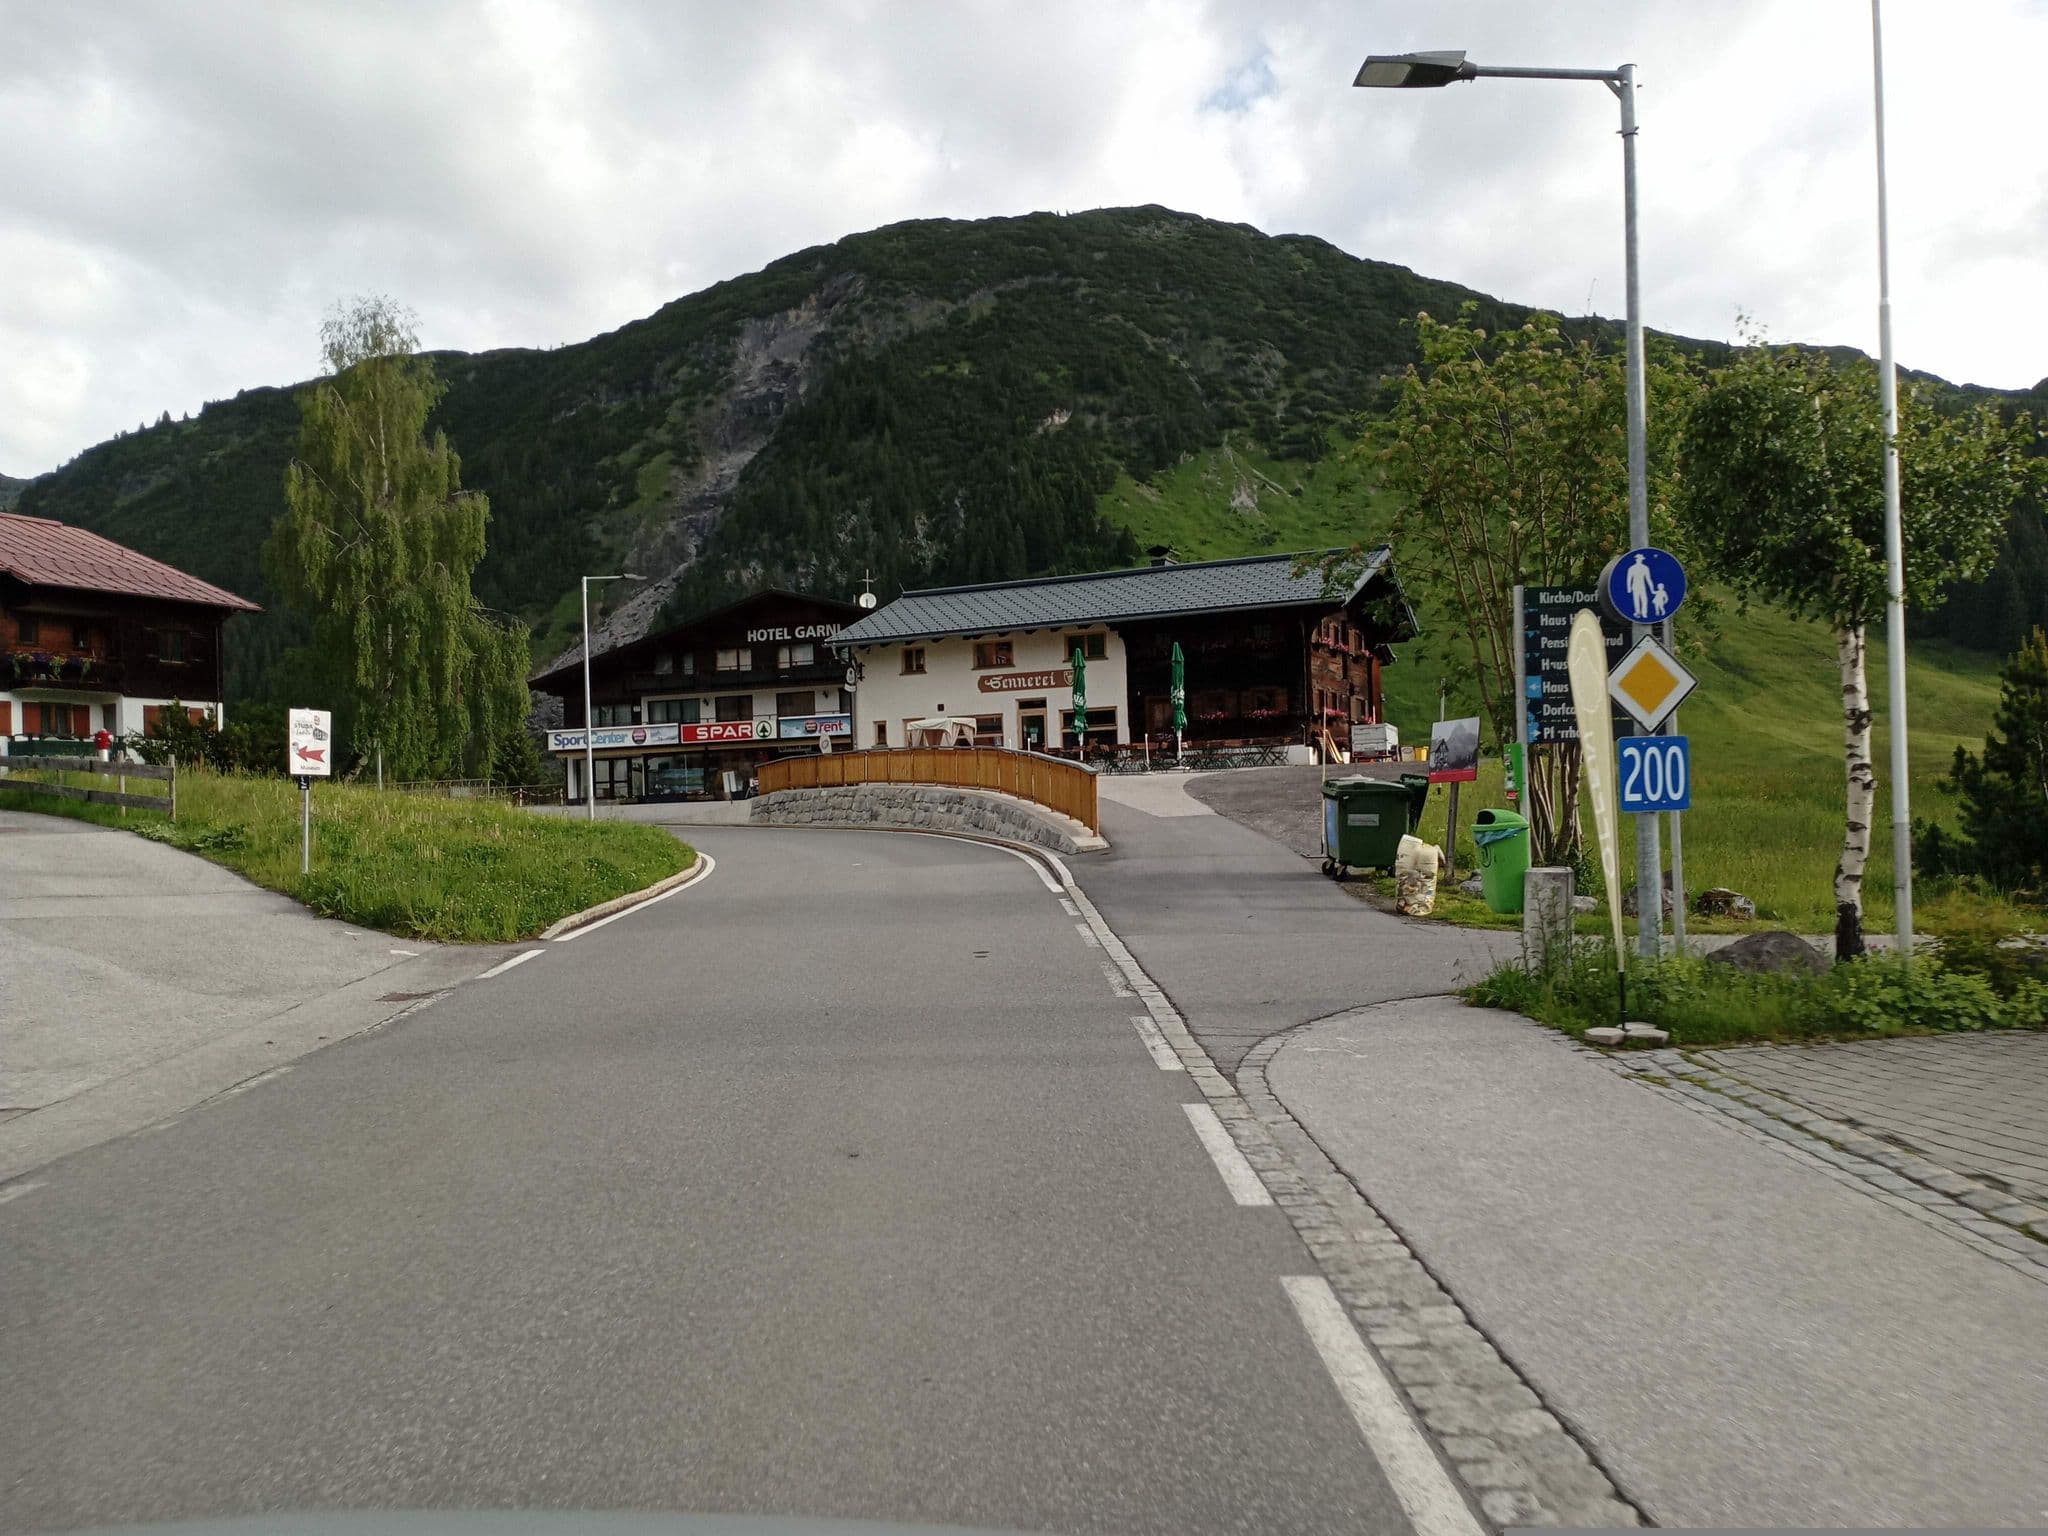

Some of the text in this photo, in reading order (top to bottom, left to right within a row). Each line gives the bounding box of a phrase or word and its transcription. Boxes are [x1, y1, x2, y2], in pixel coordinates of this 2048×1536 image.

[1539, 590, 1600, 604] Kirche/Dorf
[1540, 613, 1567, 626] Haus
[747, 627, 792, 642] HOTEL
[984, 671, 1057, 690] Sennerei
[1542, 681, 1569, 693] Haus
[696, 726, 753, 740] SPAR
[818, 720, 844, 733] rent
[1623, 746, 1686, 801] 200
